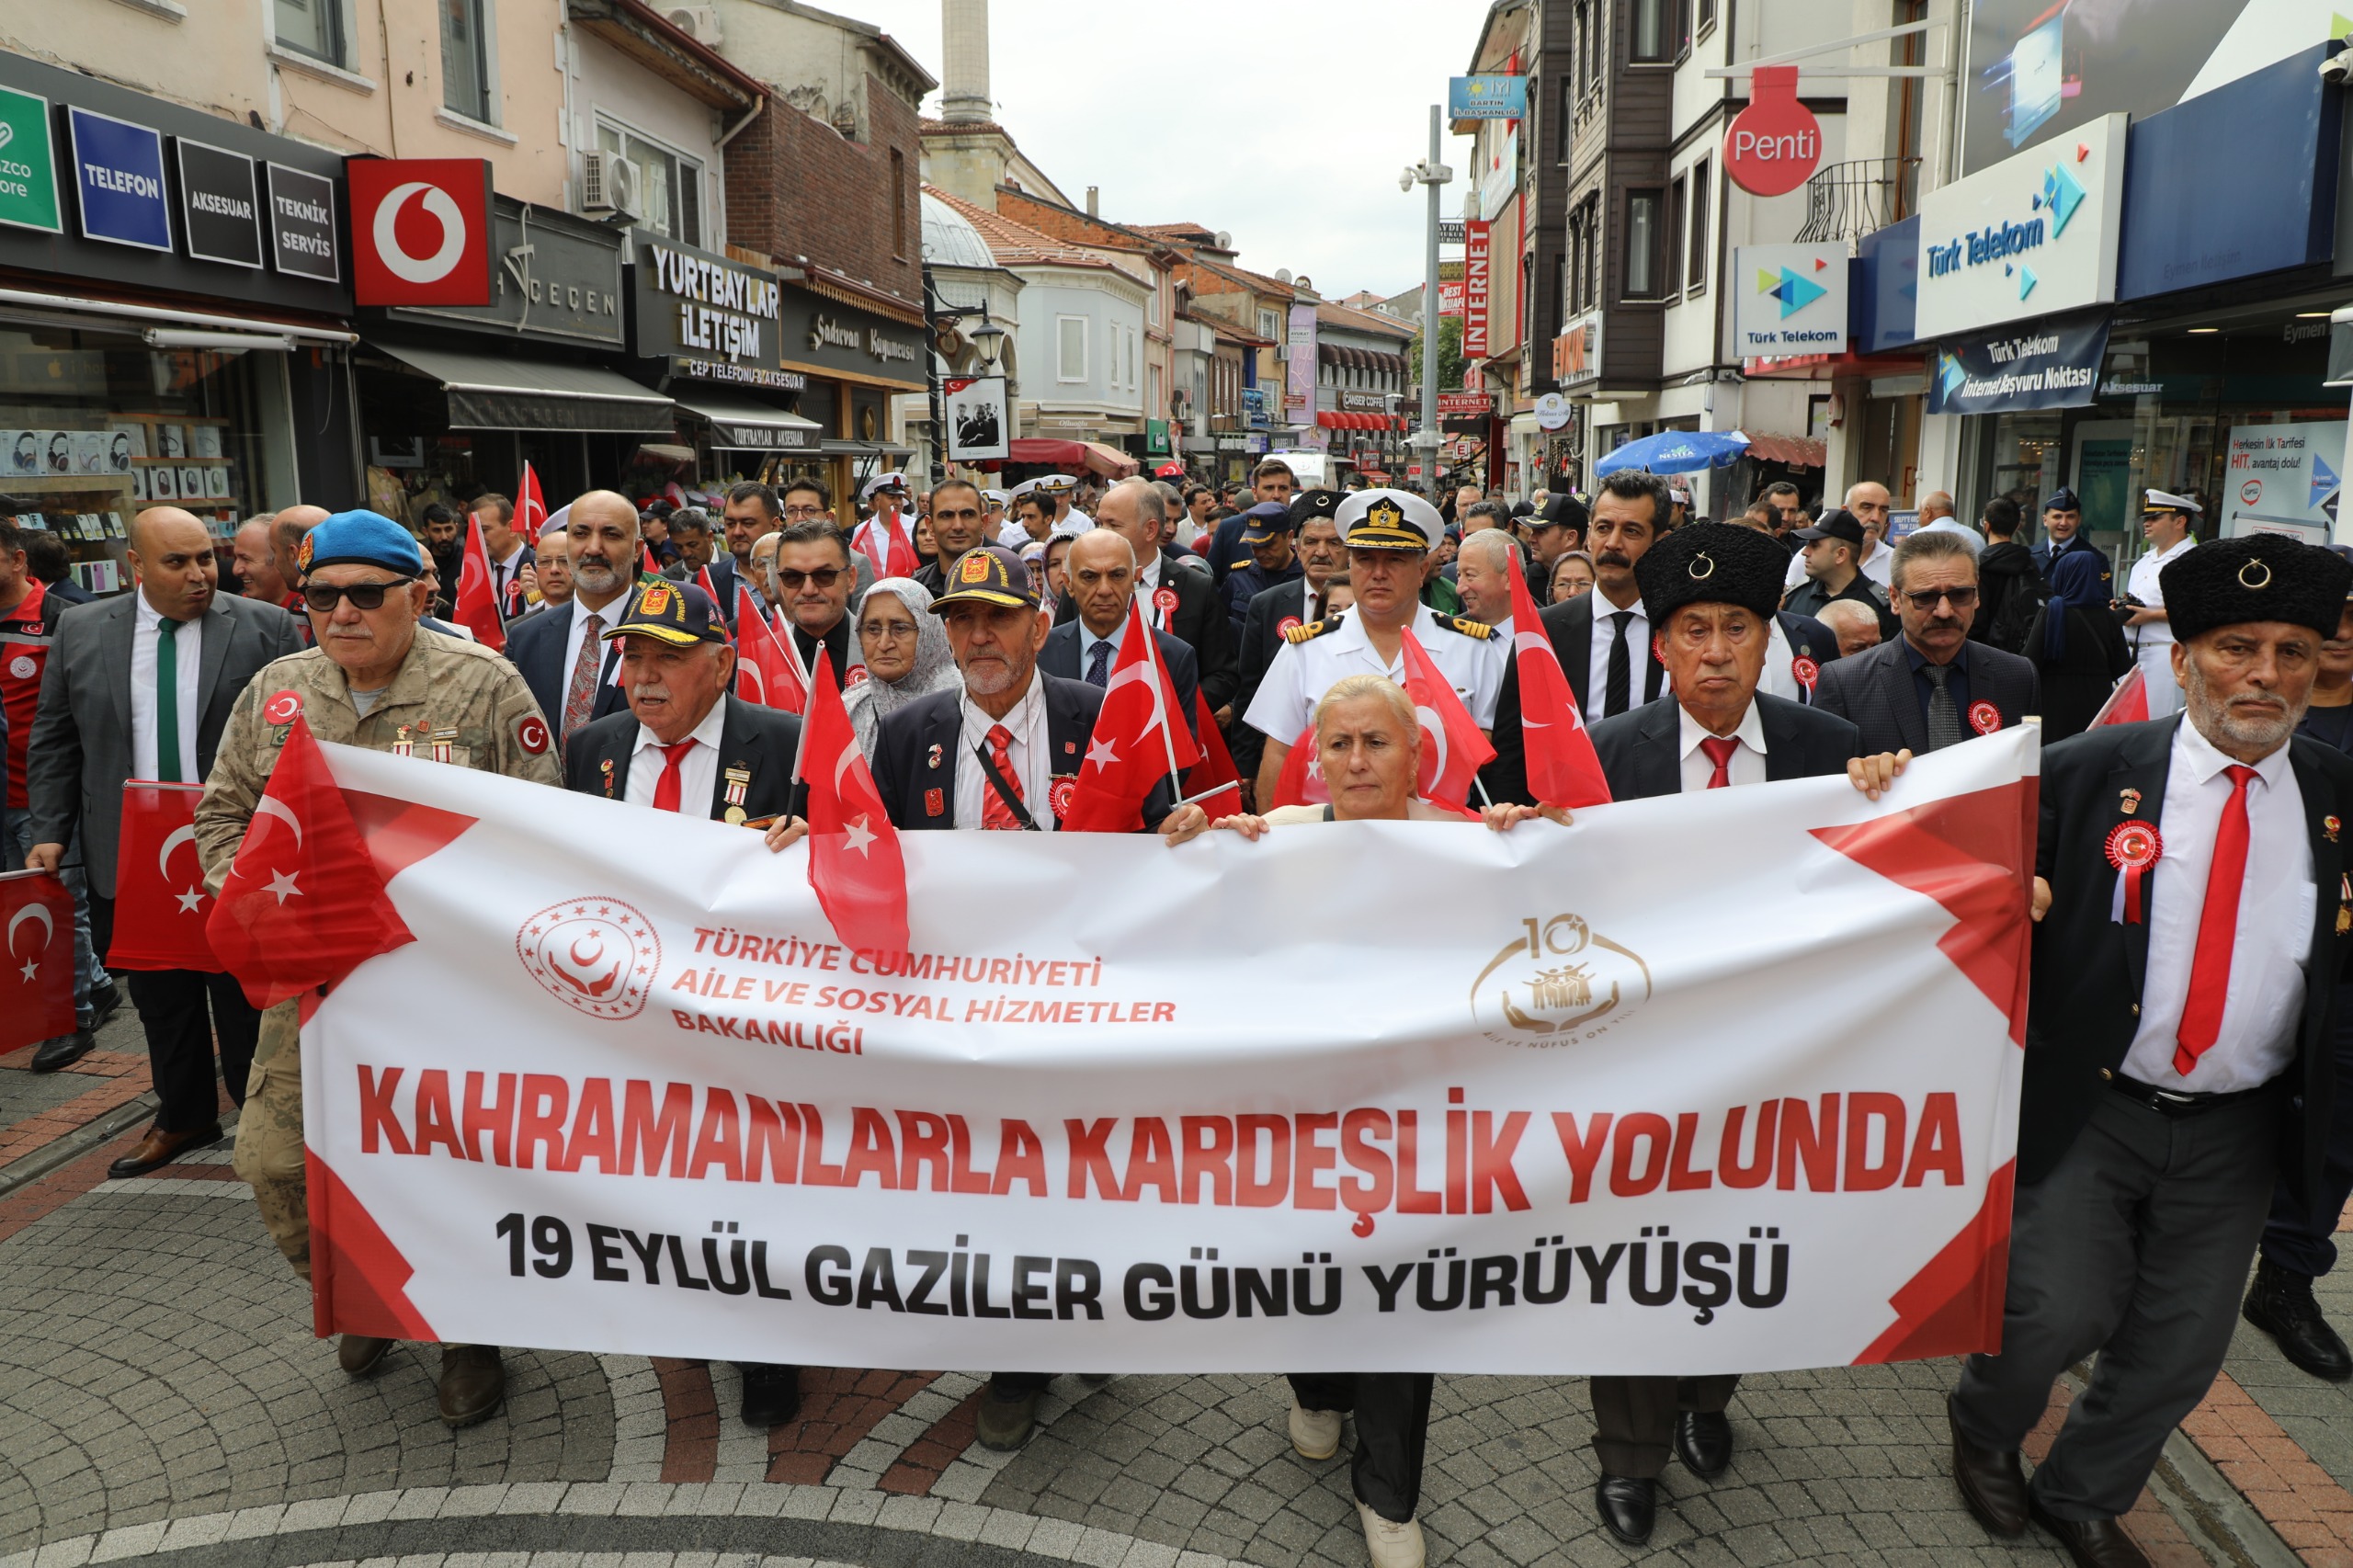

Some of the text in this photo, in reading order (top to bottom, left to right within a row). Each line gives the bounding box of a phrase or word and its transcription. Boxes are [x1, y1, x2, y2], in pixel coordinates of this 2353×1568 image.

[1464, 107, 1519, 118] BAŞKANLIĞI
[1735, 130, 1814, 161] Penti
[85, 163, 160, 199] TELEFON
[192, 190, 253, 221] AKSESUAR
[276, 196, 329, 225] TEKNİK
[282, 231, 331, 257] SERVİS
[1927, 217, 2044, 278] Türk Telekom
[652, 244, 779, 320] YURTBAYLAR
[2164, 259, 2198, 280] Eymen
[529, 278, 615, 316] ÇEÇEN
[1443, 286, 1462, 298] BEST
[1466, 228, 1488, 351] İNTERNET
[681, 303, 760, 363] İLETİŞİM
[813, 313, 915, 362] Şadırvan Kuyumcusu
[1747, 330, 1837, 344] Türk Telekom
[2283, 322, 2326, 345] Eymen
[1987, 340, 2015, 364] Türk
[689, 359, 804, 390] CEP TELEFONU & AKSESUAR
[1961, 365, 2092, 398] İnternet Başvuru Noktası
[2099, 381, 2164, 393] Aksesuar
[1343, 391, 1366, 409] CANSER
[733, 427, 804, 447] YURTBAYLAR AKSESUAR
[1059, 419, 1088, 428] Ofluoğlu
[1659, 450, 1694, 460] NESTEA
[2233, 436, 2305, 450] Herkesin İlk Tarifesi
[2231, 450, 2302, 472] HİT, avantaj dolu!
[1522, 913, 1590, 959] 10
[694, 926, 1102, 987] TÜRKİYE CUMHURİYETİ
[671, 966, 1176, 1023] AİLE VE SOSYAL HİZMETLER
[671, 1009, 864, 1055] BAKANLIĞI
[1527, 1037, 1579, 1049] NÜFUS
[1586, 1026, 1608, 1040] ON
[356, 1064, 1965, 1239] KAHRAMANLARLA KARDEŞLİK YOLUNDA
[495, 1212, 1790, 1326] 19 EYLÜL GAZİLER GÜNÜ YÜRÜYÜŞÜ
